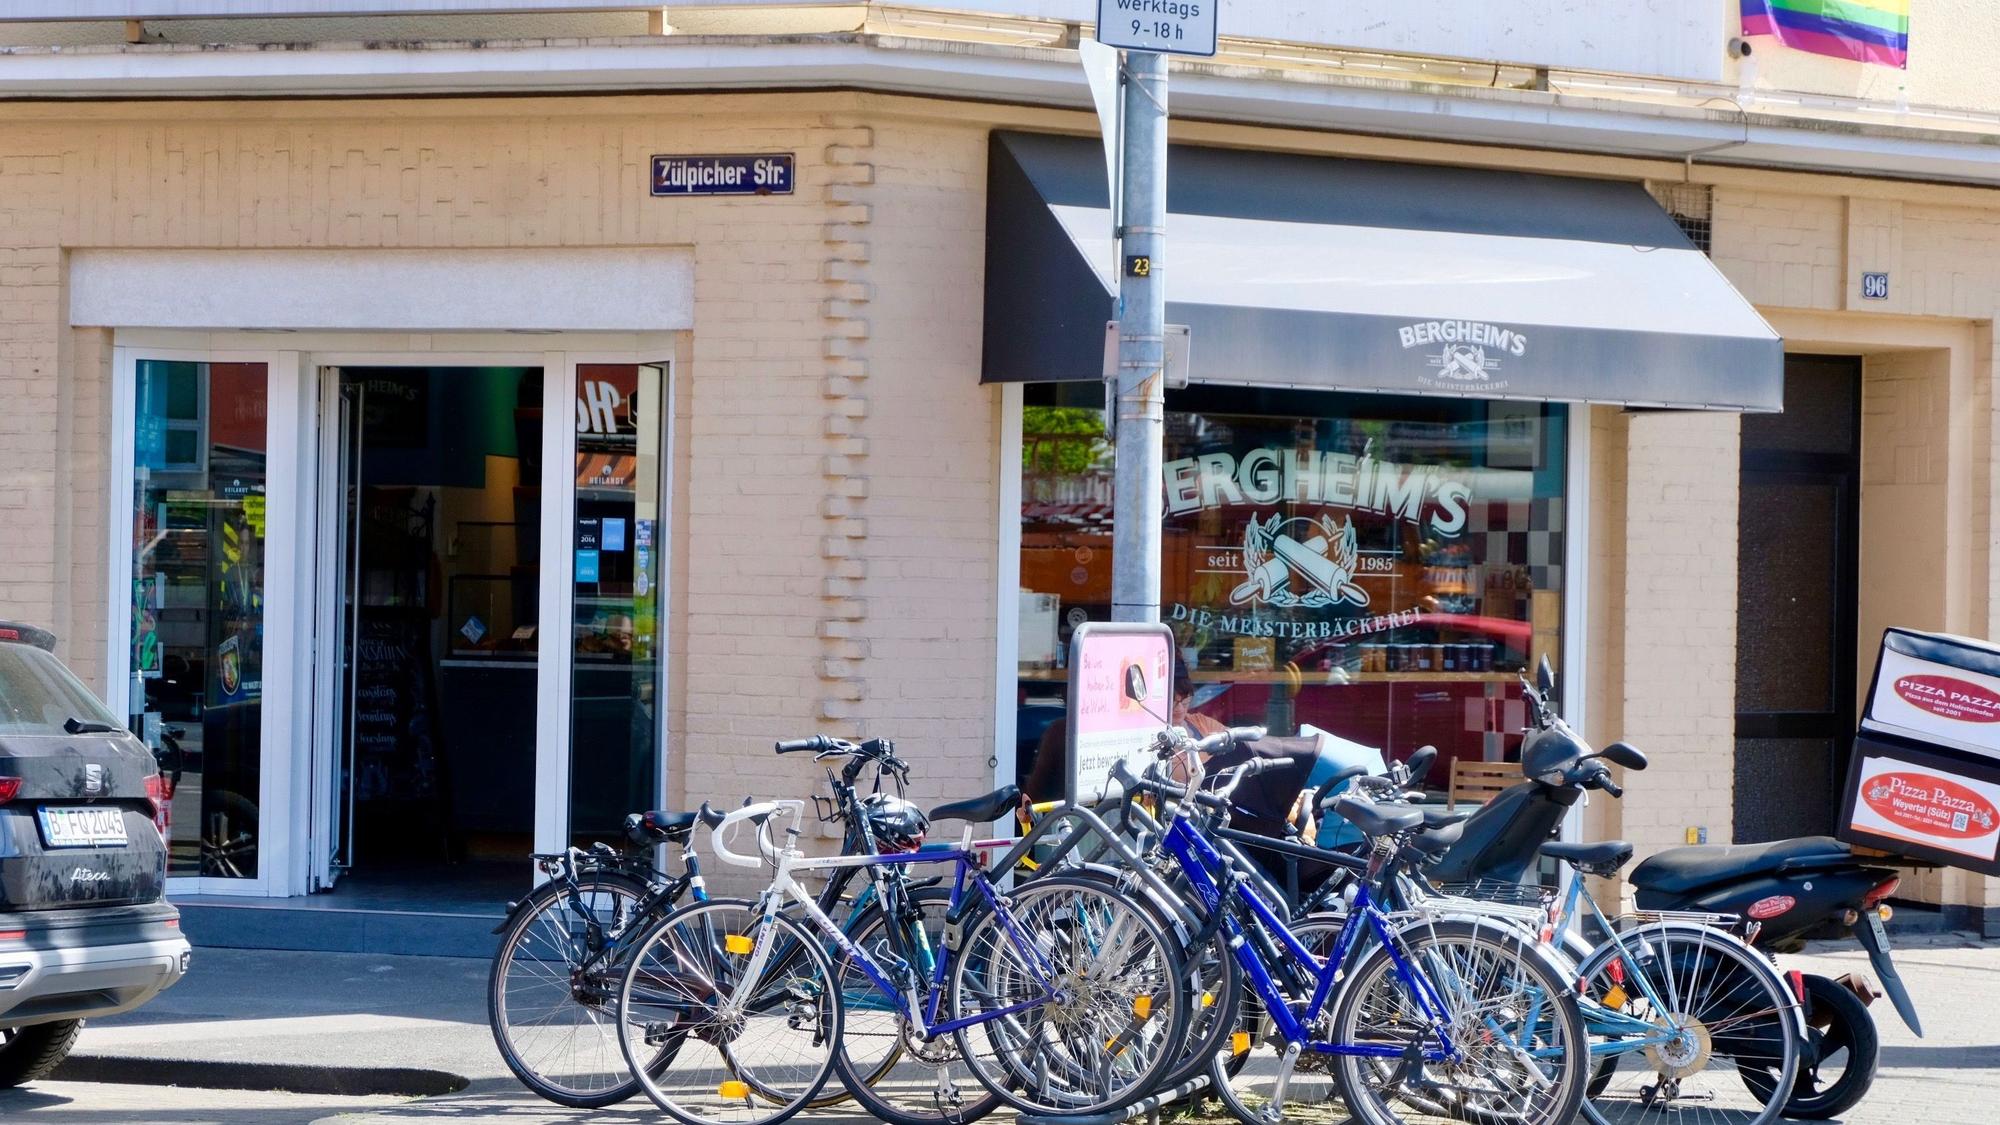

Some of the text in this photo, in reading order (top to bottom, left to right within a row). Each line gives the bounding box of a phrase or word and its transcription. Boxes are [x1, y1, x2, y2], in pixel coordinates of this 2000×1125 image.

[1175, 24, 1183, 40] h
[659, 159, 784, 192] Zülpicher Str.
[1134, 258, 1149, 272] 23
[1865, 275, 1886, 297] 96
[1399, 320, 1527, 356] BERGHEIM'S
[1161, 448, 1474, 538] ERGHEIM'S
[1208, 551, 1393, 571] seit 1985
[1171, 602, 1422, 638] DIE MEISTERBÄCKEREI
[1899, 680, 2000, 711] PIZZA PAZZA
[1904, 692, 1921, 702] Pizza
[1922, 696, 1933, 704] aus
[1949, 702, 1994, 718] Holzsteinofen
[1945, 709, 1961, 717] 2001
[1079, 755, 1095, 776] Jetzt
[1889, 777, 1976, 813] Pizza Pazza
[48, 810, 124, 836] B FQ 2045
[1892, 798, 1927, 814] Weyertal
[1927, 806, 1951, 822] (Sülz)
[70, 867, 110, 882] Ateca
[754, 925, 768, 958] GIANT
